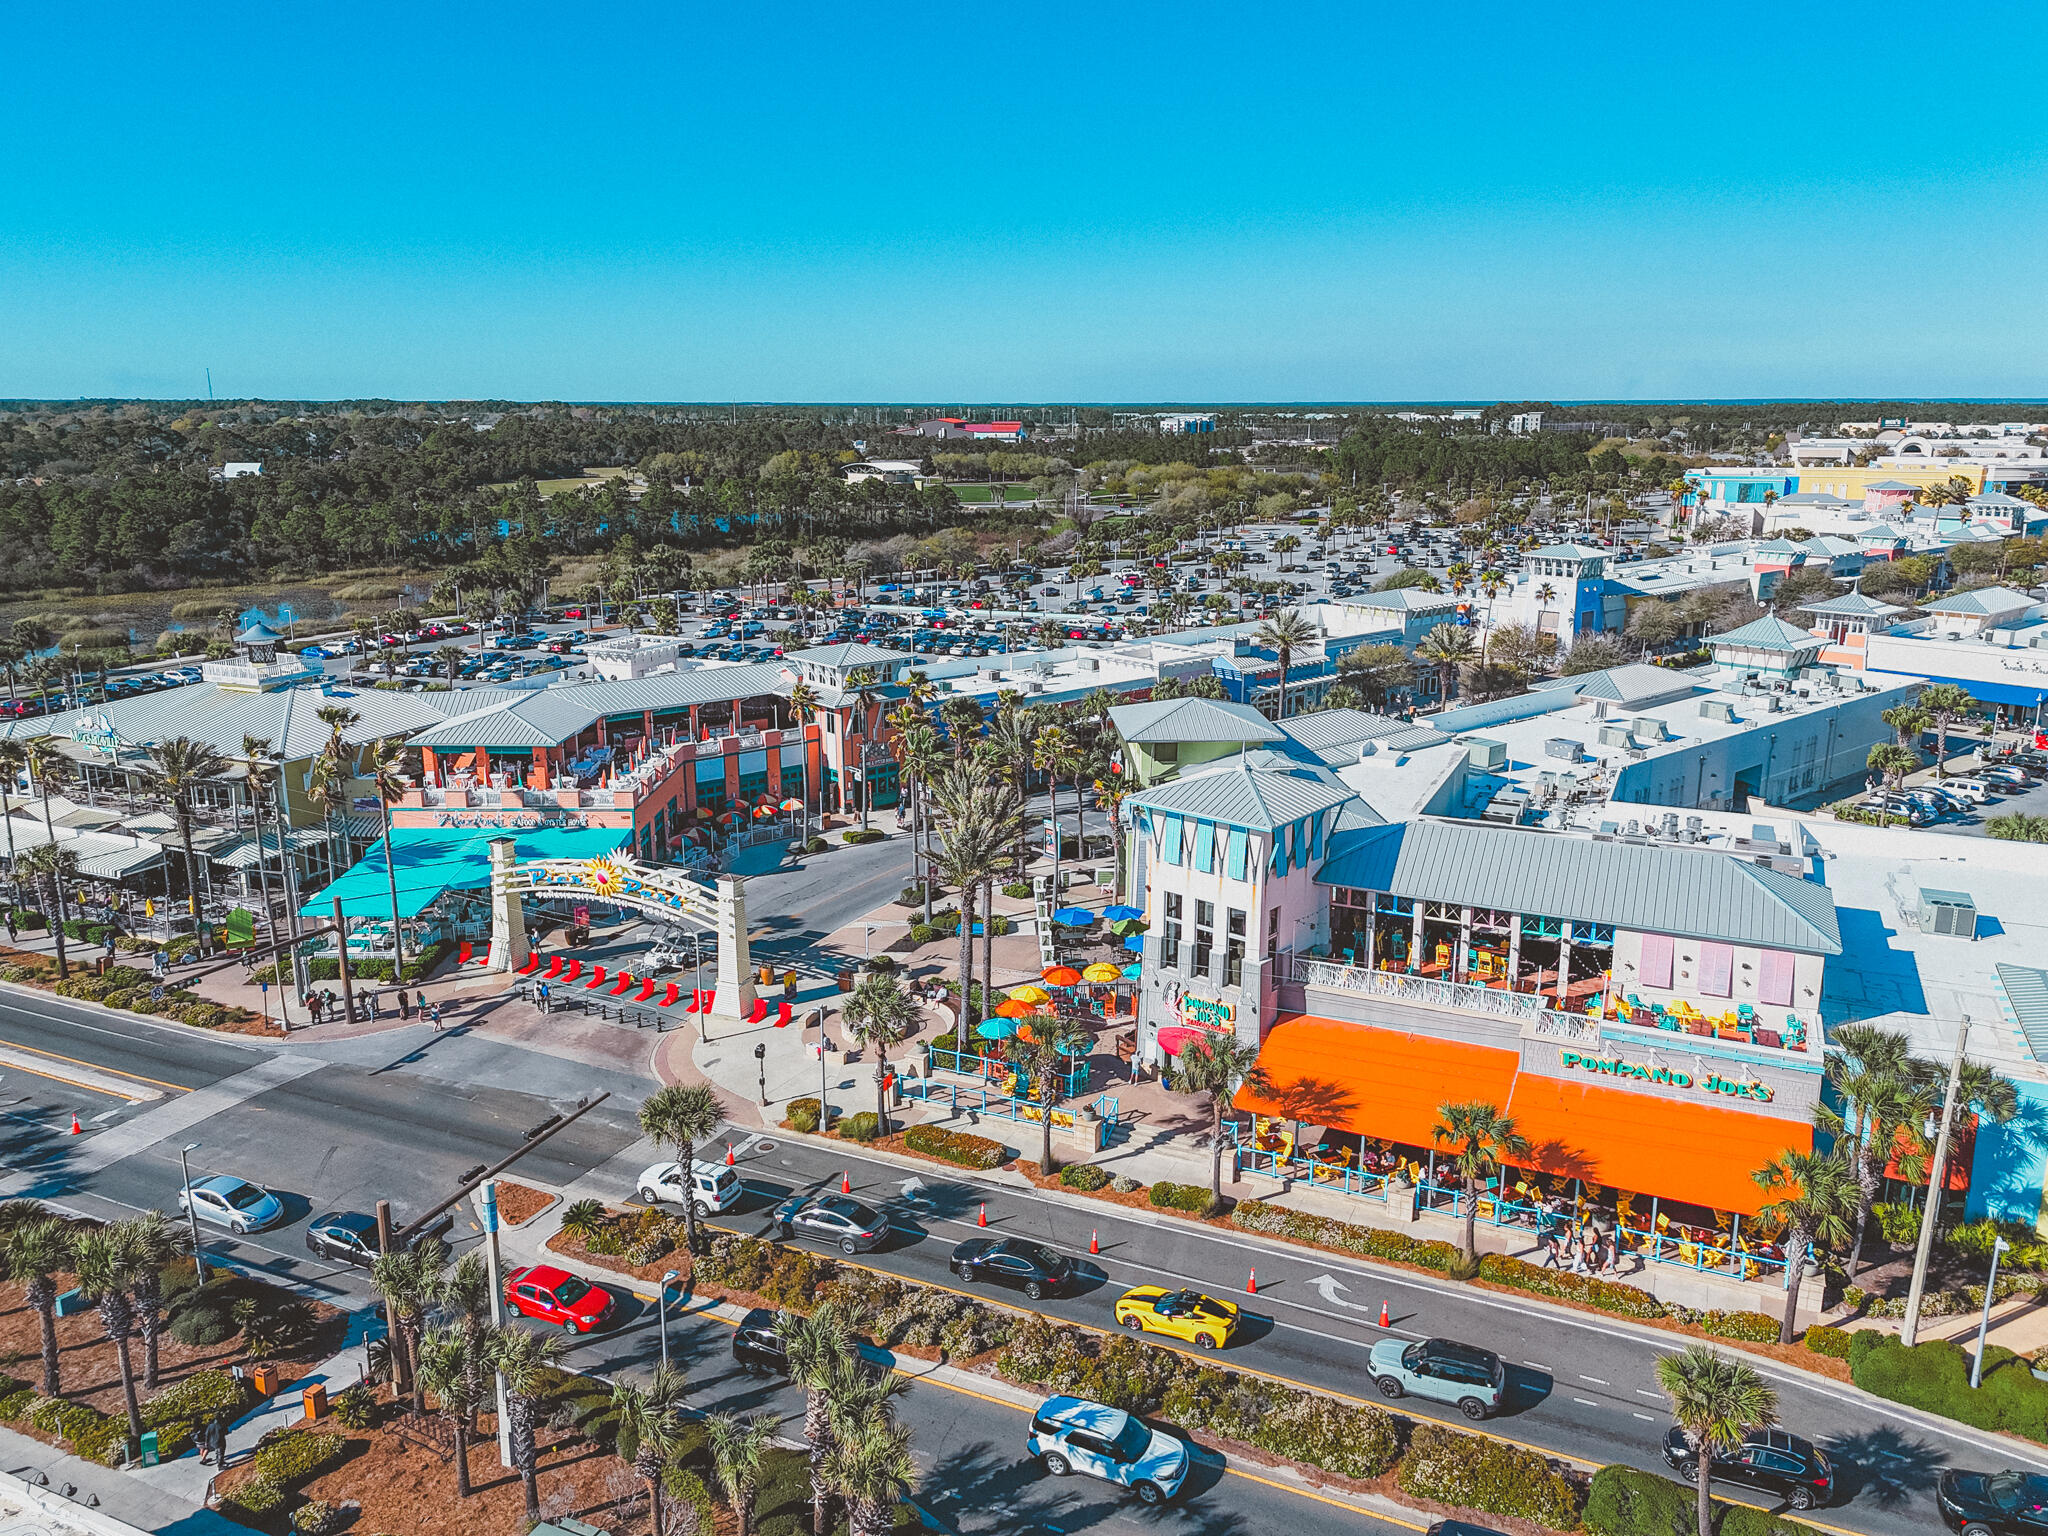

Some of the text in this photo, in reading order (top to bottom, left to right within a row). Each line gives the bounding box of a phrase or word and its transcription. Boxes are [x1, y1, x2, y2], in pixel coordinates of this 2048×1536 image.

[528, 868, 687, 909] Pier Park
[1183, 995, 1231, 1021] POMPANO
[1561, 1050, 1774, 1102] POMPANO JOE'S
